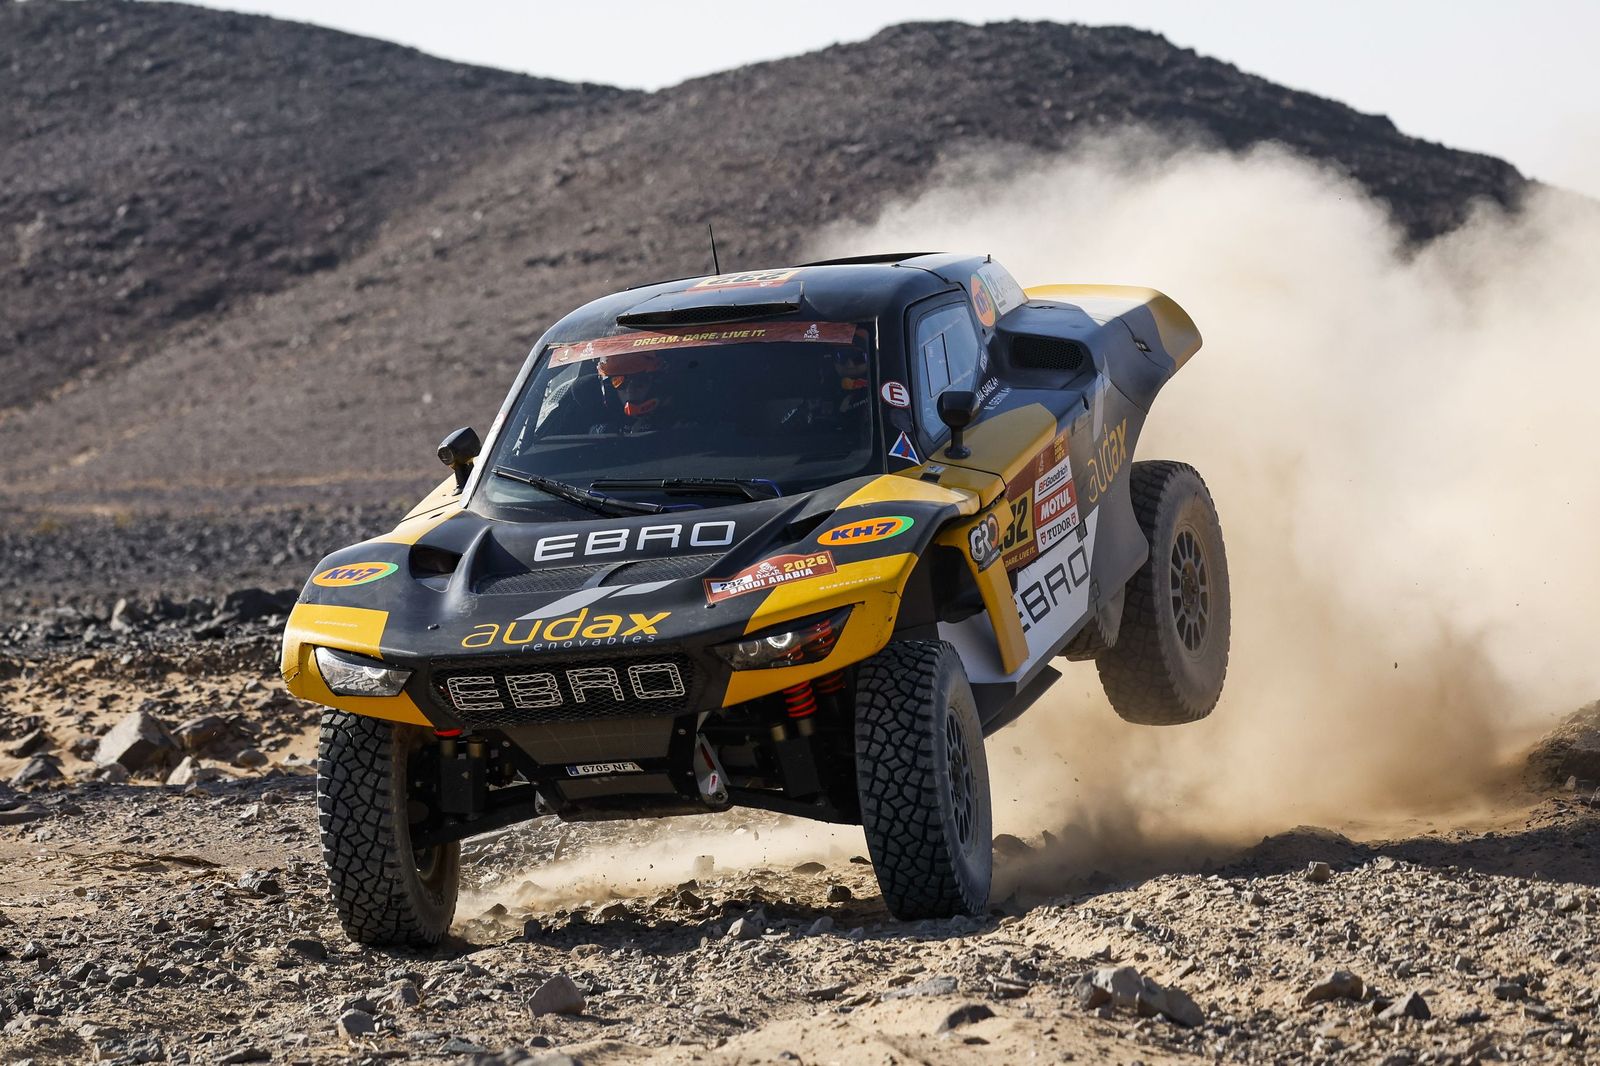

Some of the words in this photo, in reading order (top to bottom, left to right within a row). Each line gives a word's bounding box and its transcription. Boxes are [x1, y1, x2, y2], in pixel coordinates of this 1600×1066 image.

[633, 335, 679, 347] DREAM.
[682, 332, 719, 342] DARE.
[721, 330, 751, 340] LIVE
[751, 329, 766, 337] IT.
[888, 385, 905, 403] E
[1088, 418, 1127, 503] audax
[1040, 488, 1072, 521] MOTUL
[1046, 516, 1072, 540] TUDOR
[534, 520, 736, 562] EBRO
[783, 555, 828, 573] 2026
[719, 579, 745, 591] 232
[729, 580, 766, 595] SAUDI
[768, 568, 814, 585] ARABIA
[461, 608, 672, 648] audax
[521, 633, 656, 653] renovables
[447, 663, 686, 711] EBRO
[582, 763, 610, 773] 6705
